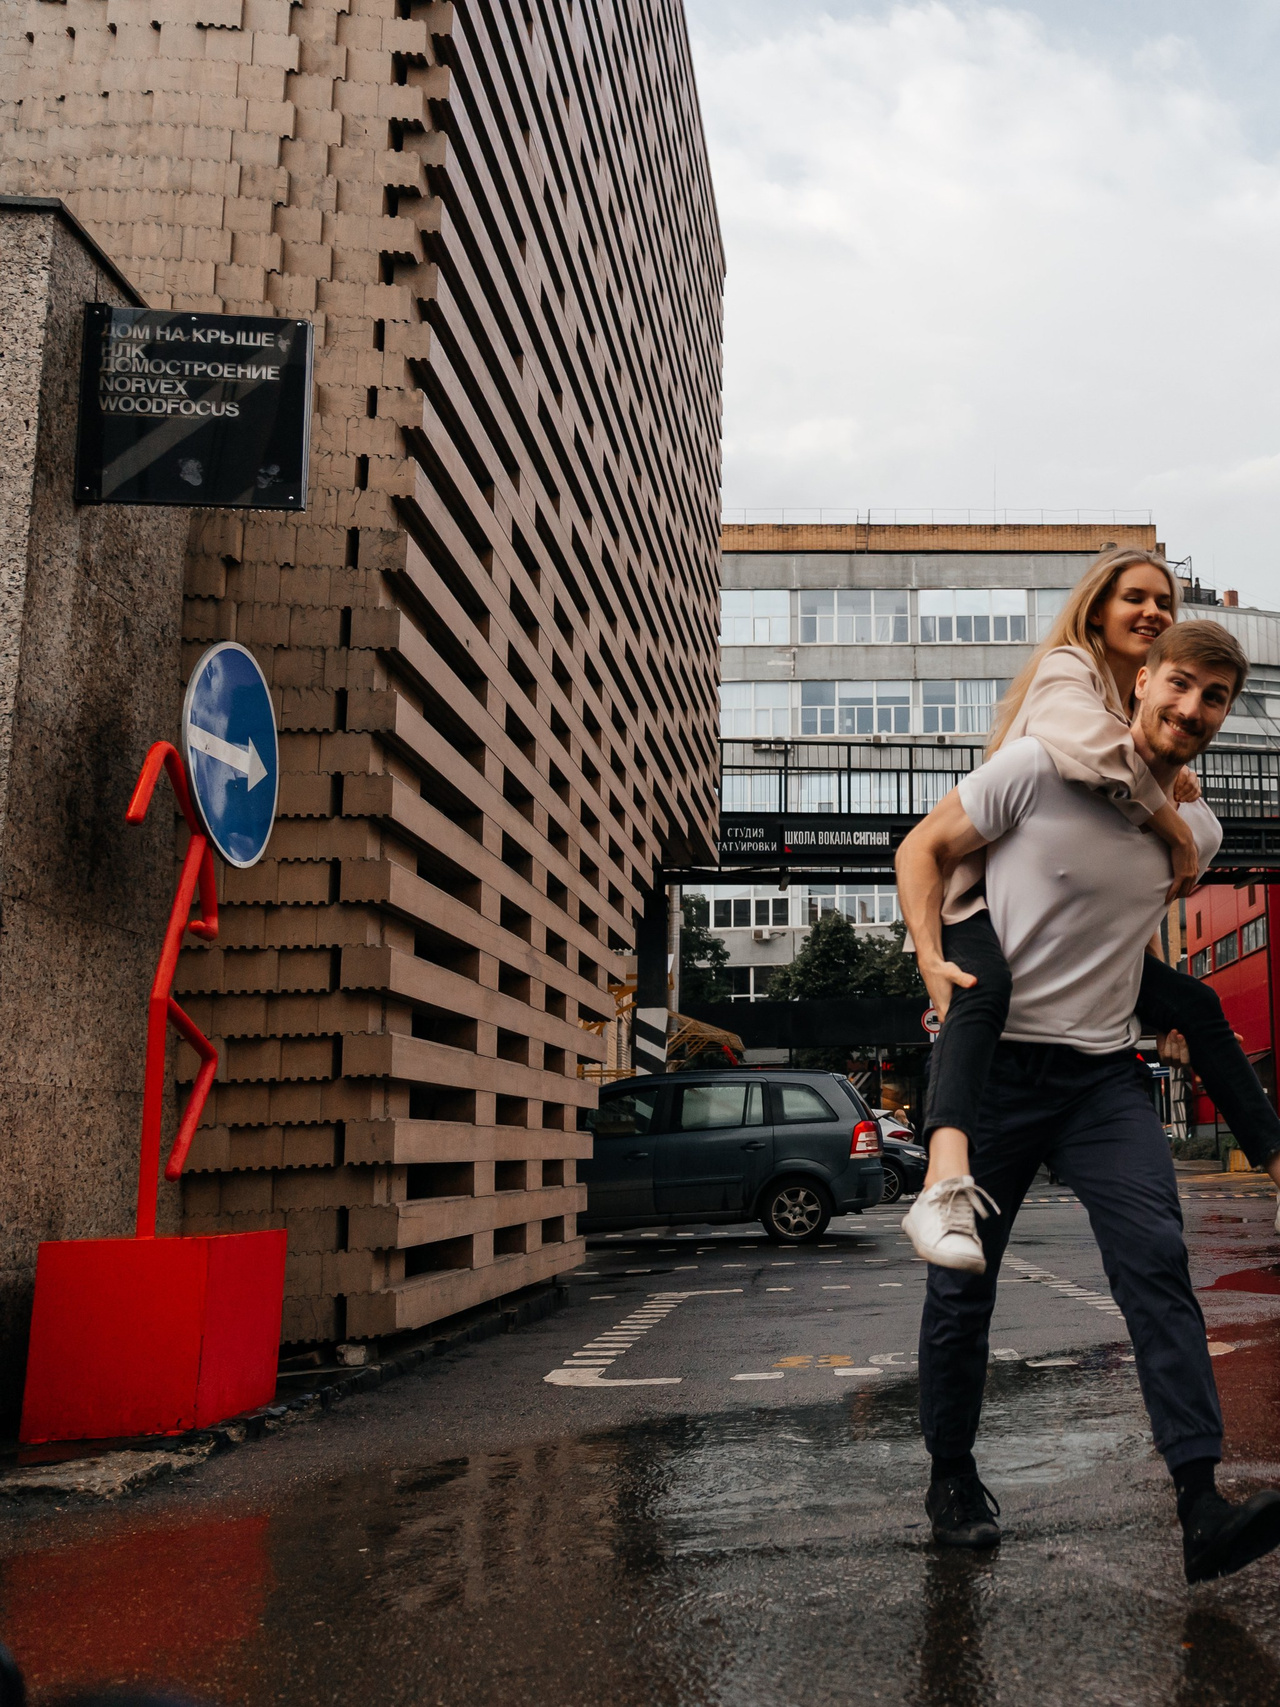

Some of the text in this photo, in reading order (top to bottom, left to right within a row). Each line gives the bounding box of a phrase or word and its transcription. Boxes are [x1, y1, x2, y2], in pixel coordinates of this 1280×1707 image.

[101, 322, 275, 348] ДОМ НА КРЫШЕ
[101, 341, 147, 359] НЛК
[100, 356, 281, 381] ДОМОСТРОЕНИЕ
[99, 375, 188, 396] NORVEX
[99, 395, 240, 418] WOODFOCUS
[727, 827, 765, 839] СТУДИЯ
[784, 831, 816, 845] ШКОЛА
[818, 831, 852, 845] ВОКАЛА
[716, 840, 778, 852] ТАТУИРОВКИ
